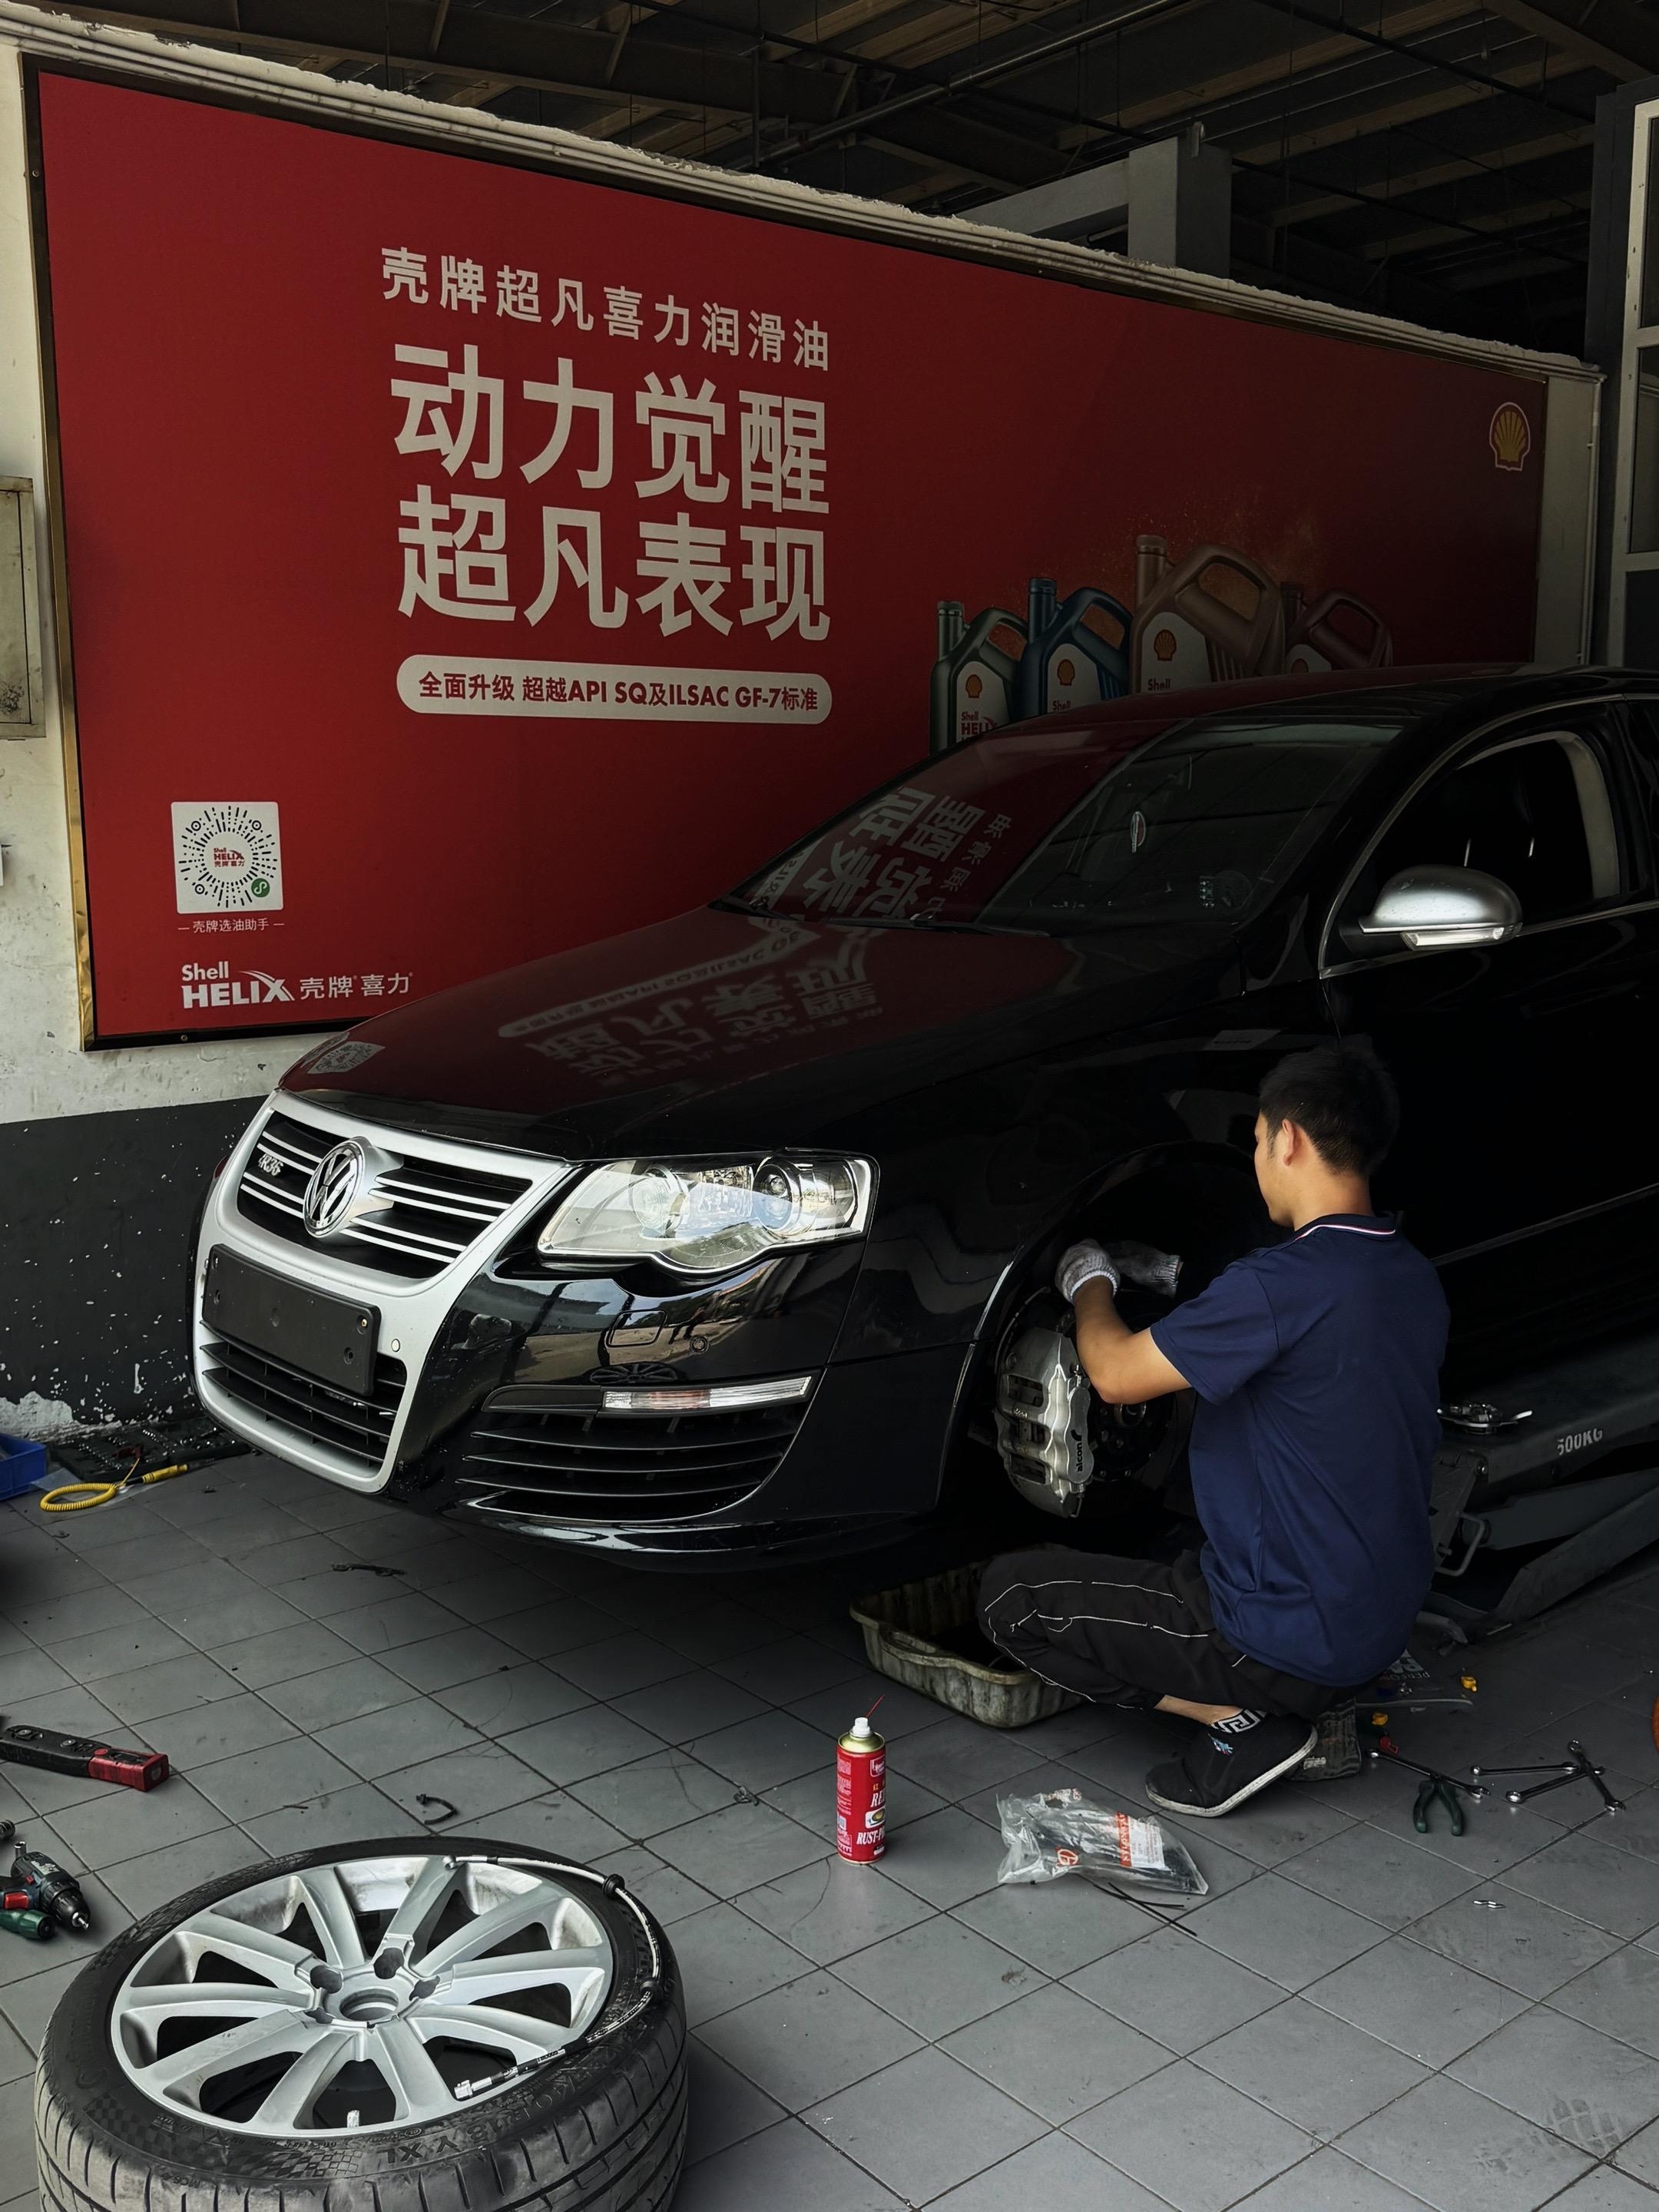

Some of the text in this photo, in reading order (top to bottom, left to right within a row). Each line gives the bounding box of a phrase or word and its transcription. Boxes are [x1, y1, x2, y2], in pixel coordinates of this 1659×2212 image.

[381, 247, 830, 371] 壳牌超凡喜力润滑油
[390, 343, 830, 514] 动力觉醒
[397, 484, 831, 641] 超凡表现
[419, 671, 819, 711] 全面升级 超越API SQ及ILSAC GF-7标准
[962, 711, 979, 721] Shell
[193, 918, 269, 934] 壳牌选油助手
[181, 961, 229, 982] Shell
[181, 970, 296, 1009] HELIX
[1557, 1428, 1604, 1456] 500KG
